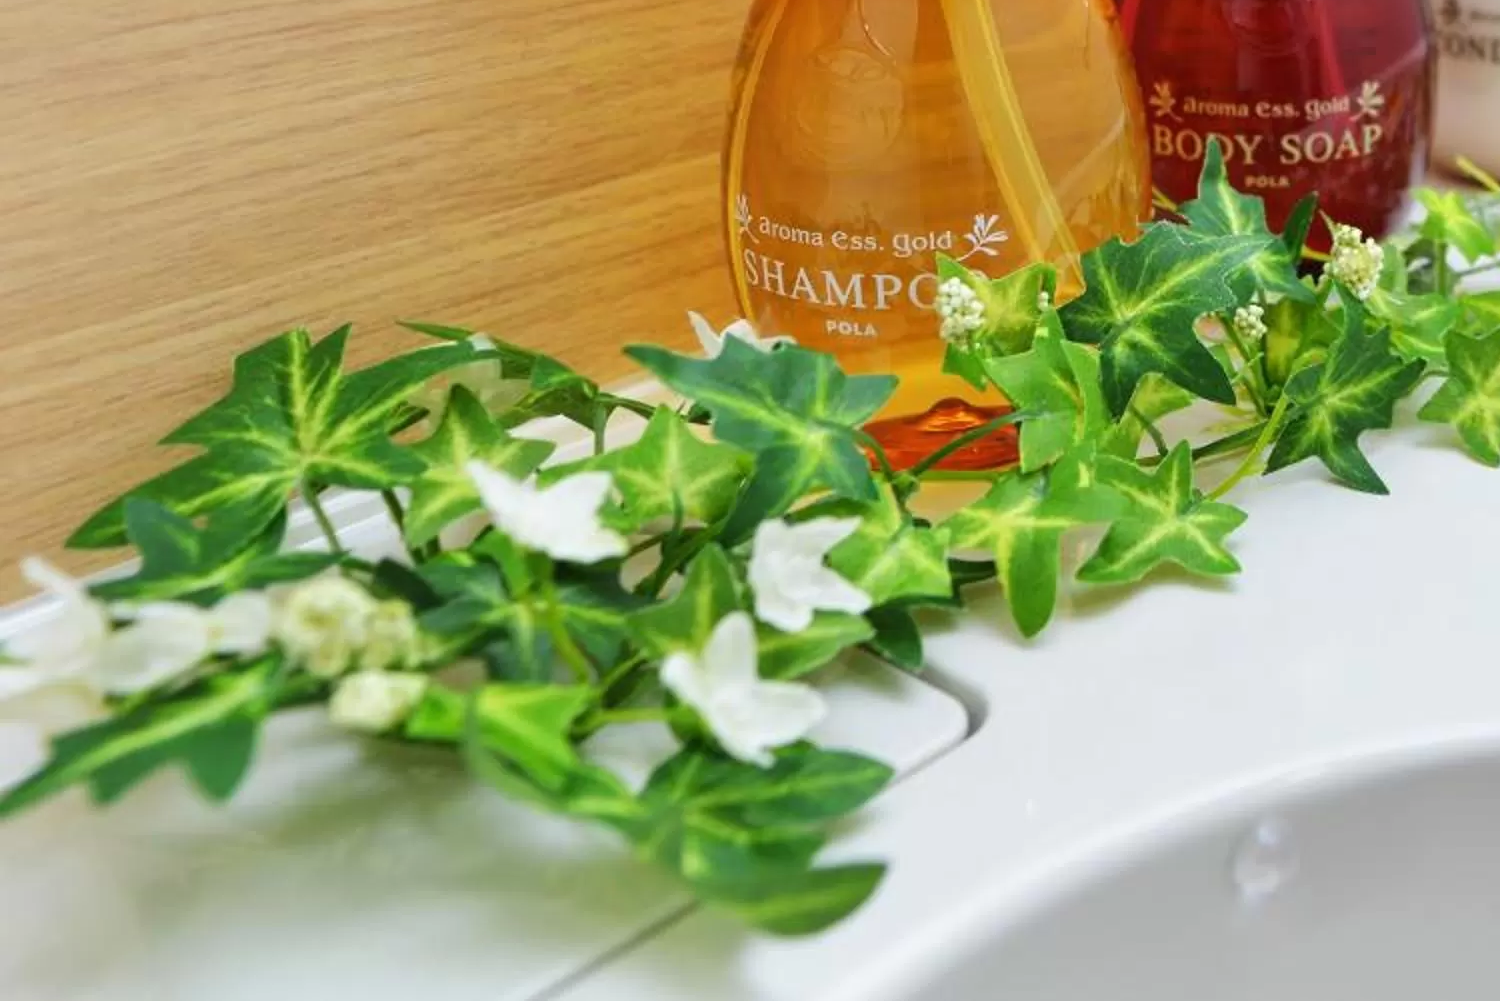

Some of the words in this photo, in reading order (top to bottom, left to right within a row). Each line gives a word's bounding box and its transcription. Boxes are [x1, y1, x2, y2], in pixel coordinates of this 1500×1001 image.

[1183, 96, 1249, 118] aroma
[1304, 95, 1350, 120] gold
[1152, 124, 1263, 165] BODY
[1279, 124, 1383, 165] SOAP
[1244, 175, 1291, 188] POLA
[758, 214, 825, 248] aroma
[893, 229, 953, 257] gold
[743, 248, 989, 311] SHAMPO
[826, 319, 878, 338] POLA
